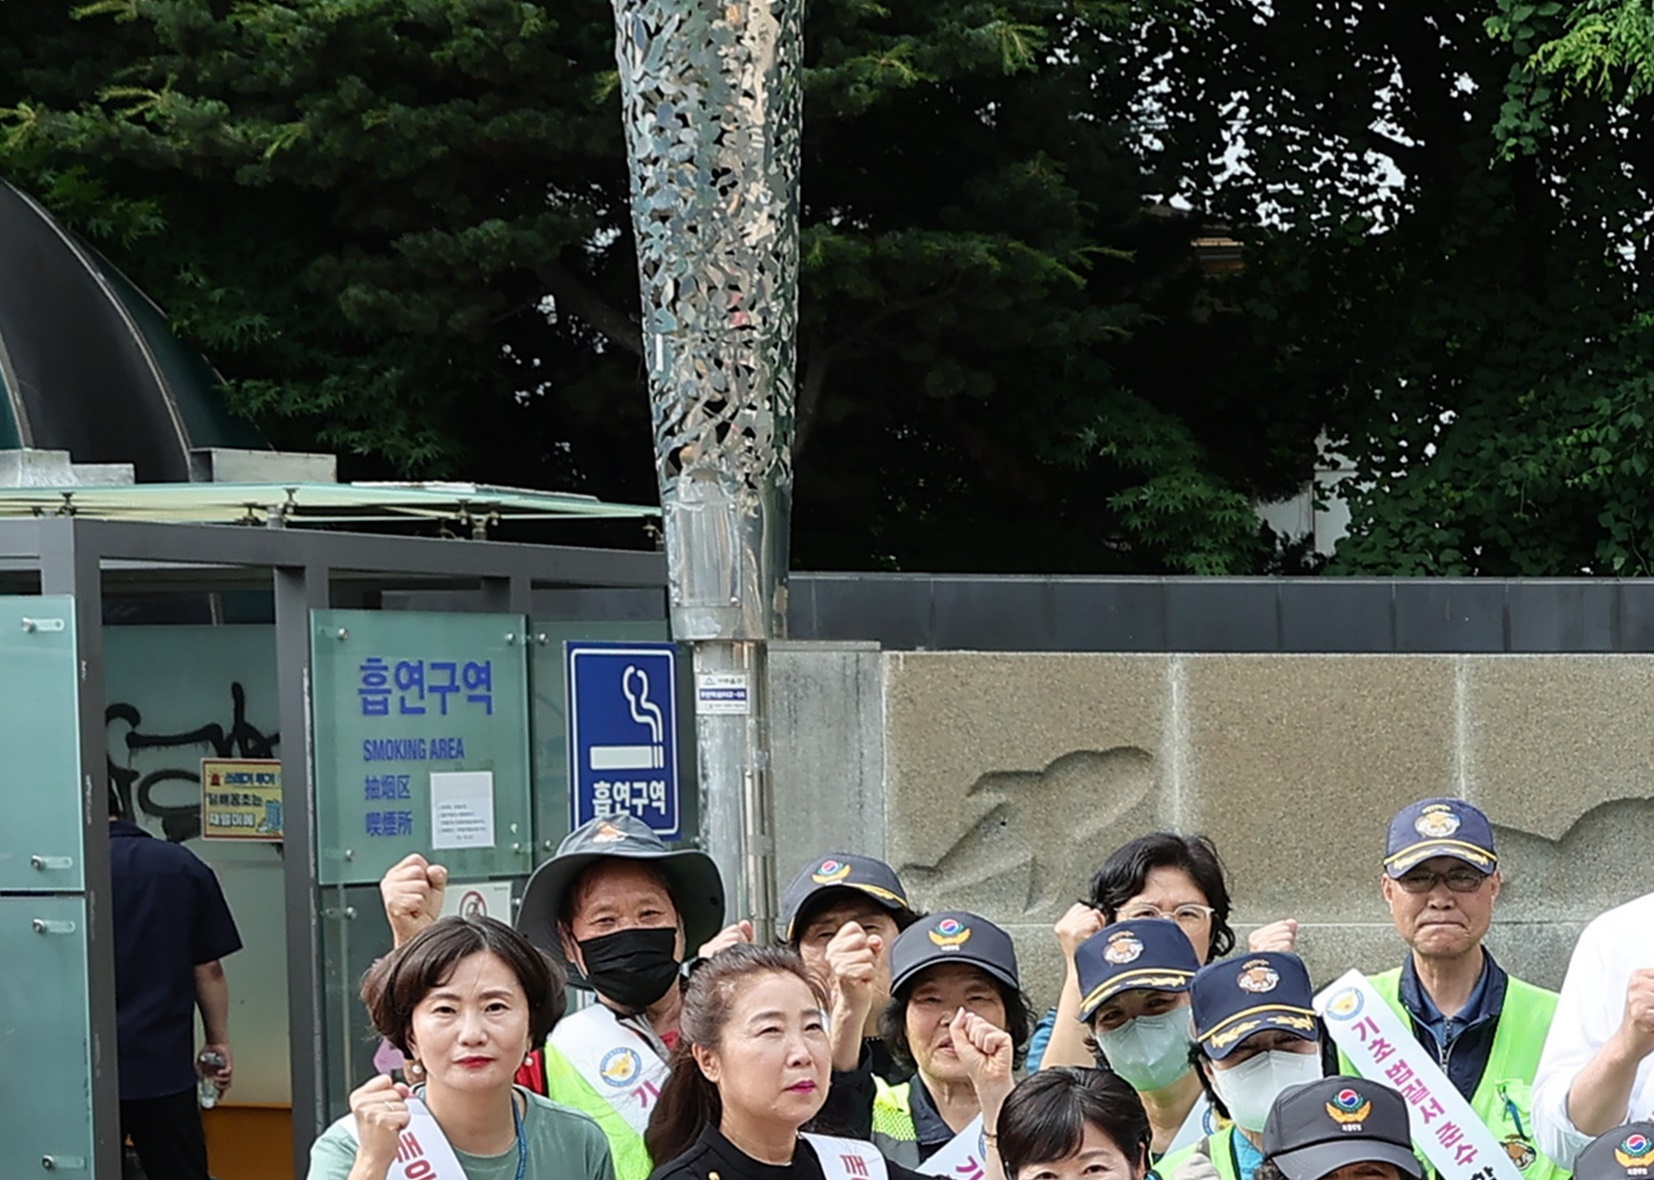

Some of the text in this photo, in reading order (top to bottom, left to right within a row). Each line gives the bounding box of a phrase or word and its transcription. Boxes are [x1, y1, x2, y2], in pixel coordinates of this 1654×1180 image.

[358, 657, 493, 716] 흡연구역
[363, 736, 465, 761] SMOKING AREA
[592, 780, 665, 817] 흡연구역
[1350, 1015, 1397, 1064] 기초
[1384, 1064, 1446, 1125] 법질서
[1434, 1124, 1480, 1168] 준수
